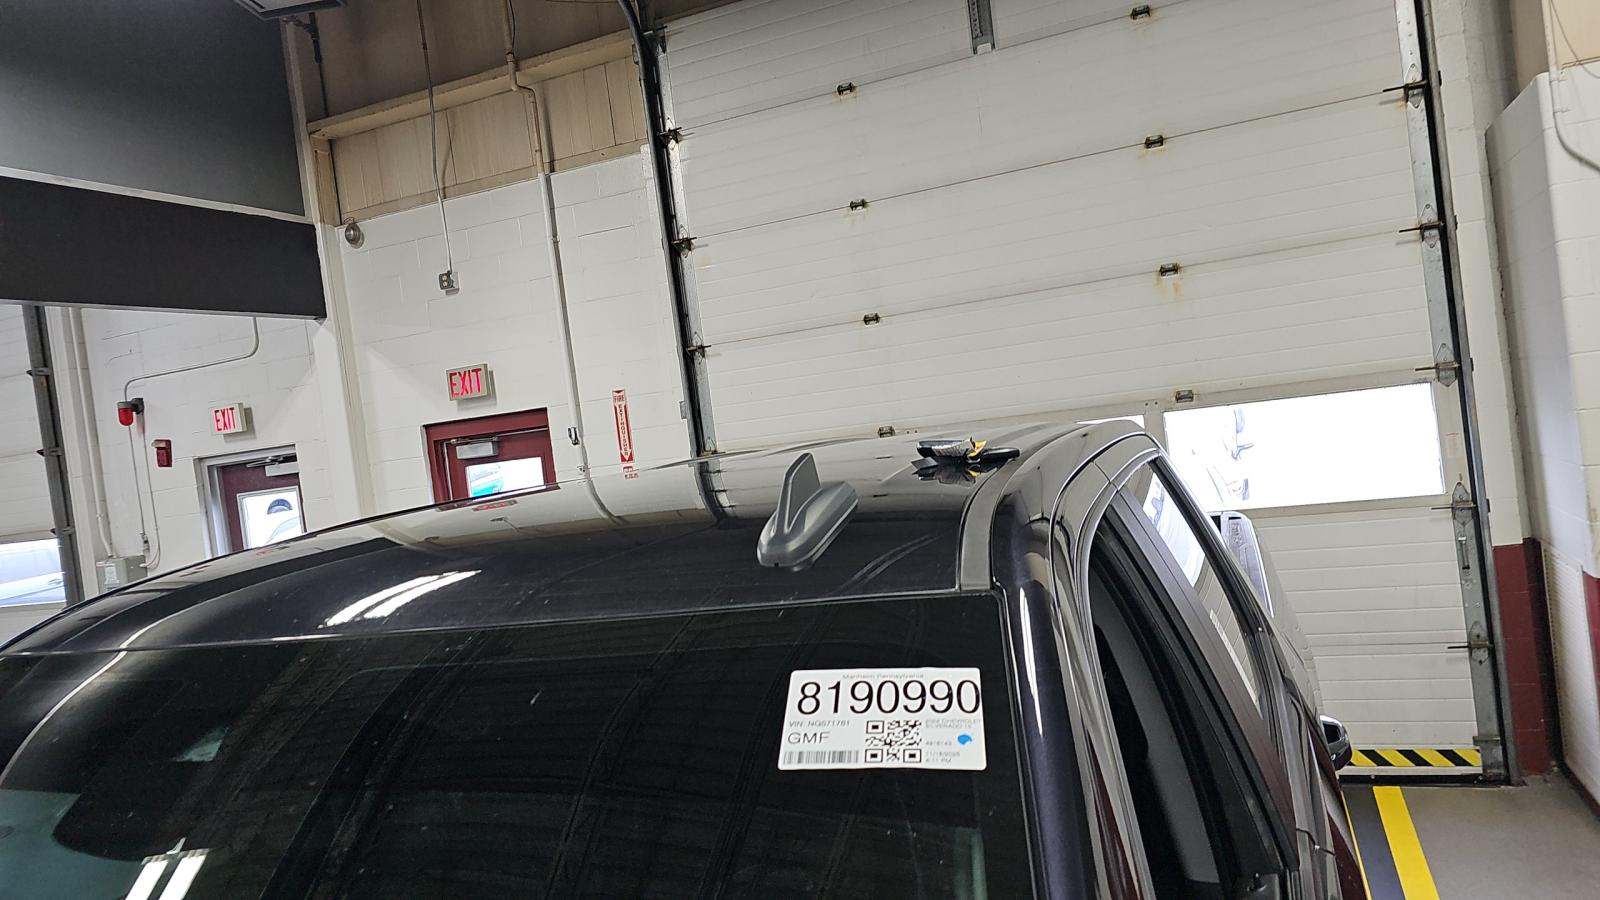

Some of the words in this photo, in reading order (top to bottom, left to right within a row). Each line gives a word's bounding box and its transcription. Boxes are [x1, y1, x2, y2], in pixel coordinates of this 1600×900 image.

[449, 368, 483, 398] EXIT
[214, 407, 236, 432] EXIT
[797, 680, 980, 715] 8190990
[787, 731, 830, 745] GMF
